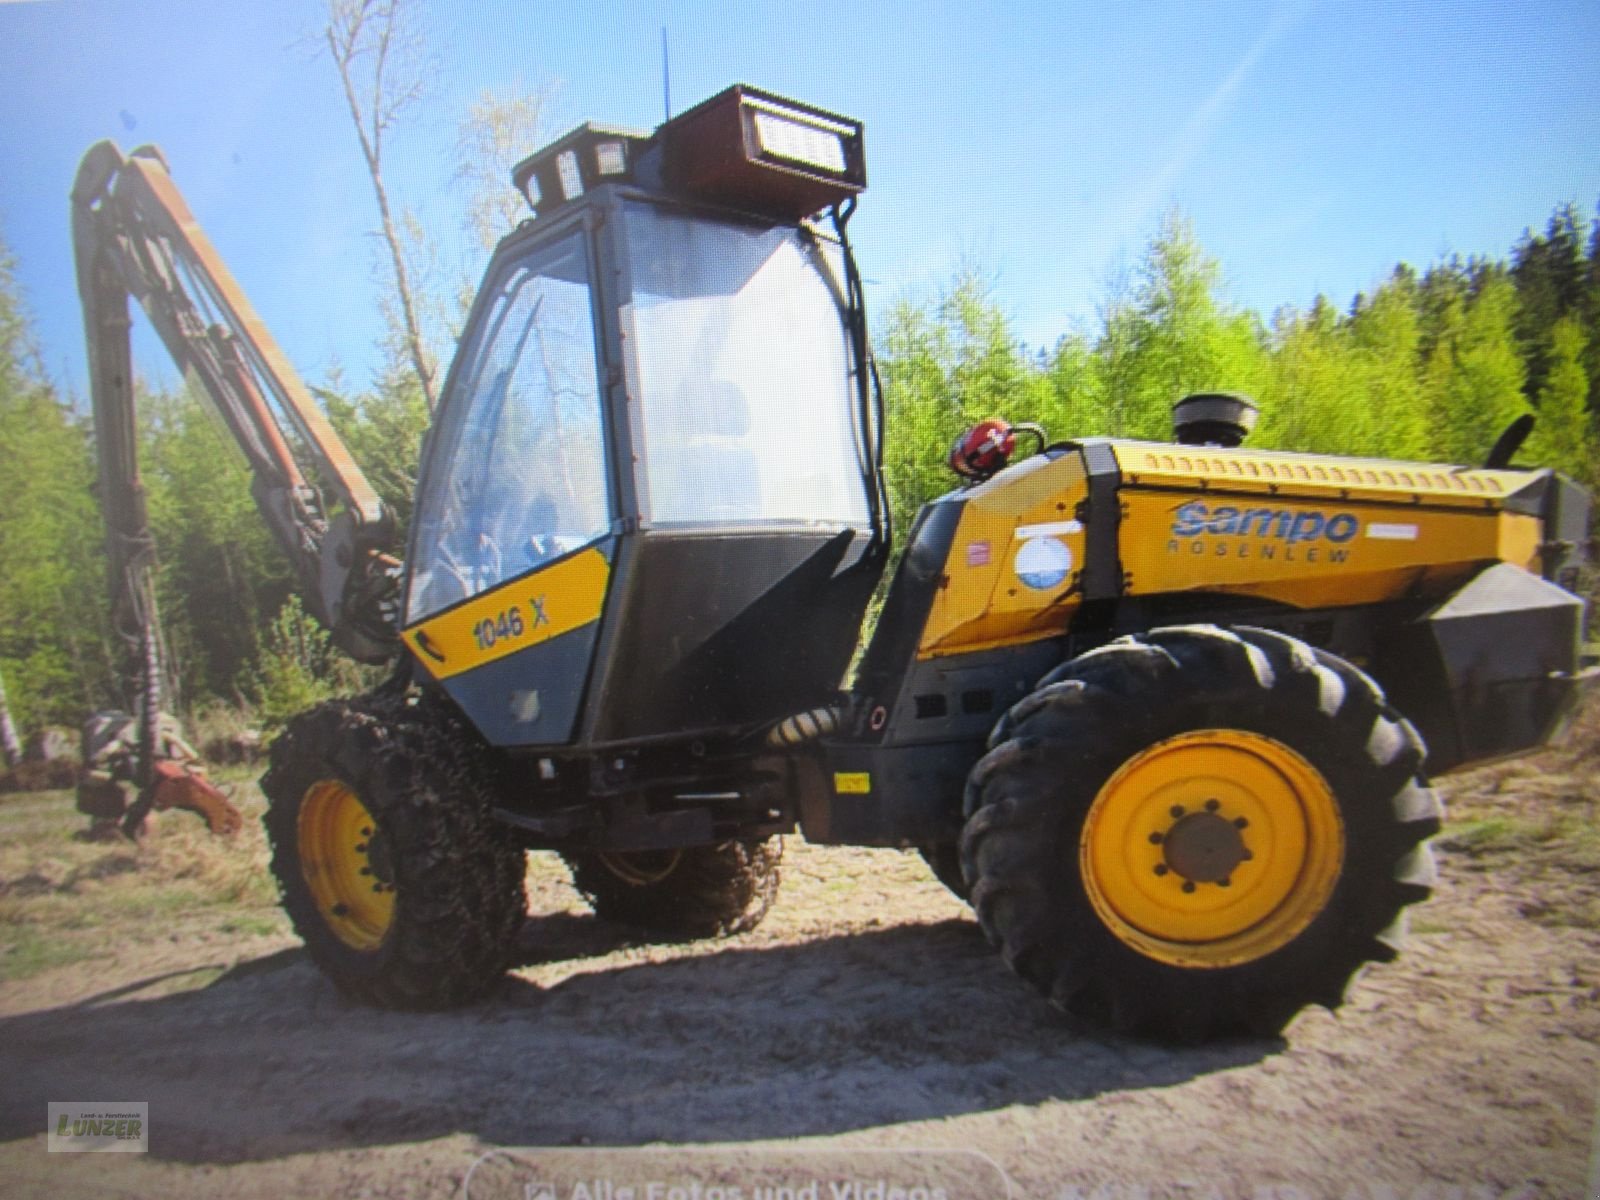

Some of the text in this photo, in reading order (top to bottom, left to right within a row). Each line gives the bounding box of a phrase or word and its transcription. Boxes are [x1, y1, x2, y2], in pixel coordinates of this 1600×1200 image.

[1167, 539, 1348, 563] ROSENLEW
[473, 593, 549, 650] 1046 X
[571, 1179, 637, 1200] Alle
